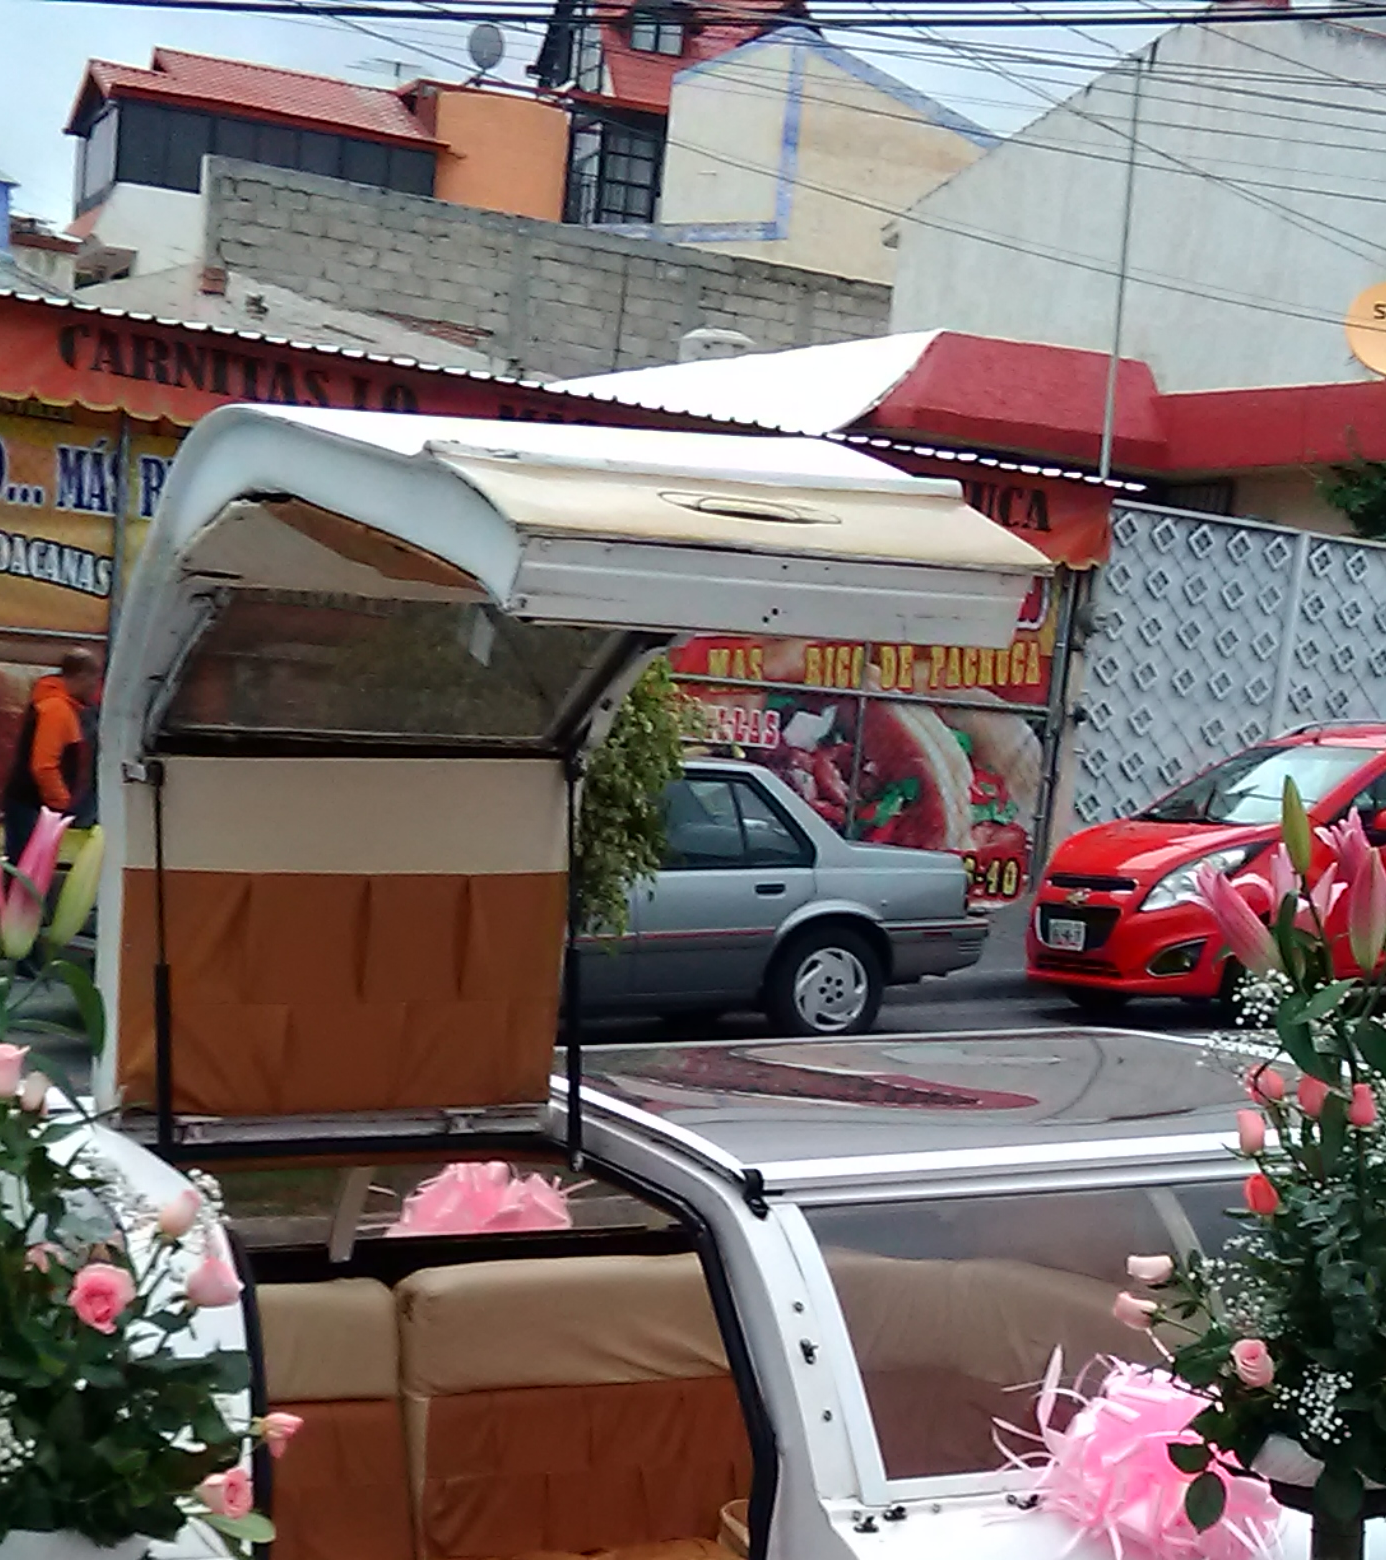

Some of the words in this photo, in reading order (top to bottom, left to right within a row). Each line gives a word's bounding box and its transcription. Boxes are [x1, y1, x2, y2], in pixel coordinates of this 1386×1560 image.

[59, 325, 331, 405] CARNITAS
[879, 645, 914, 689] DE
[929, 641, 1041, 688] PACHUCA
